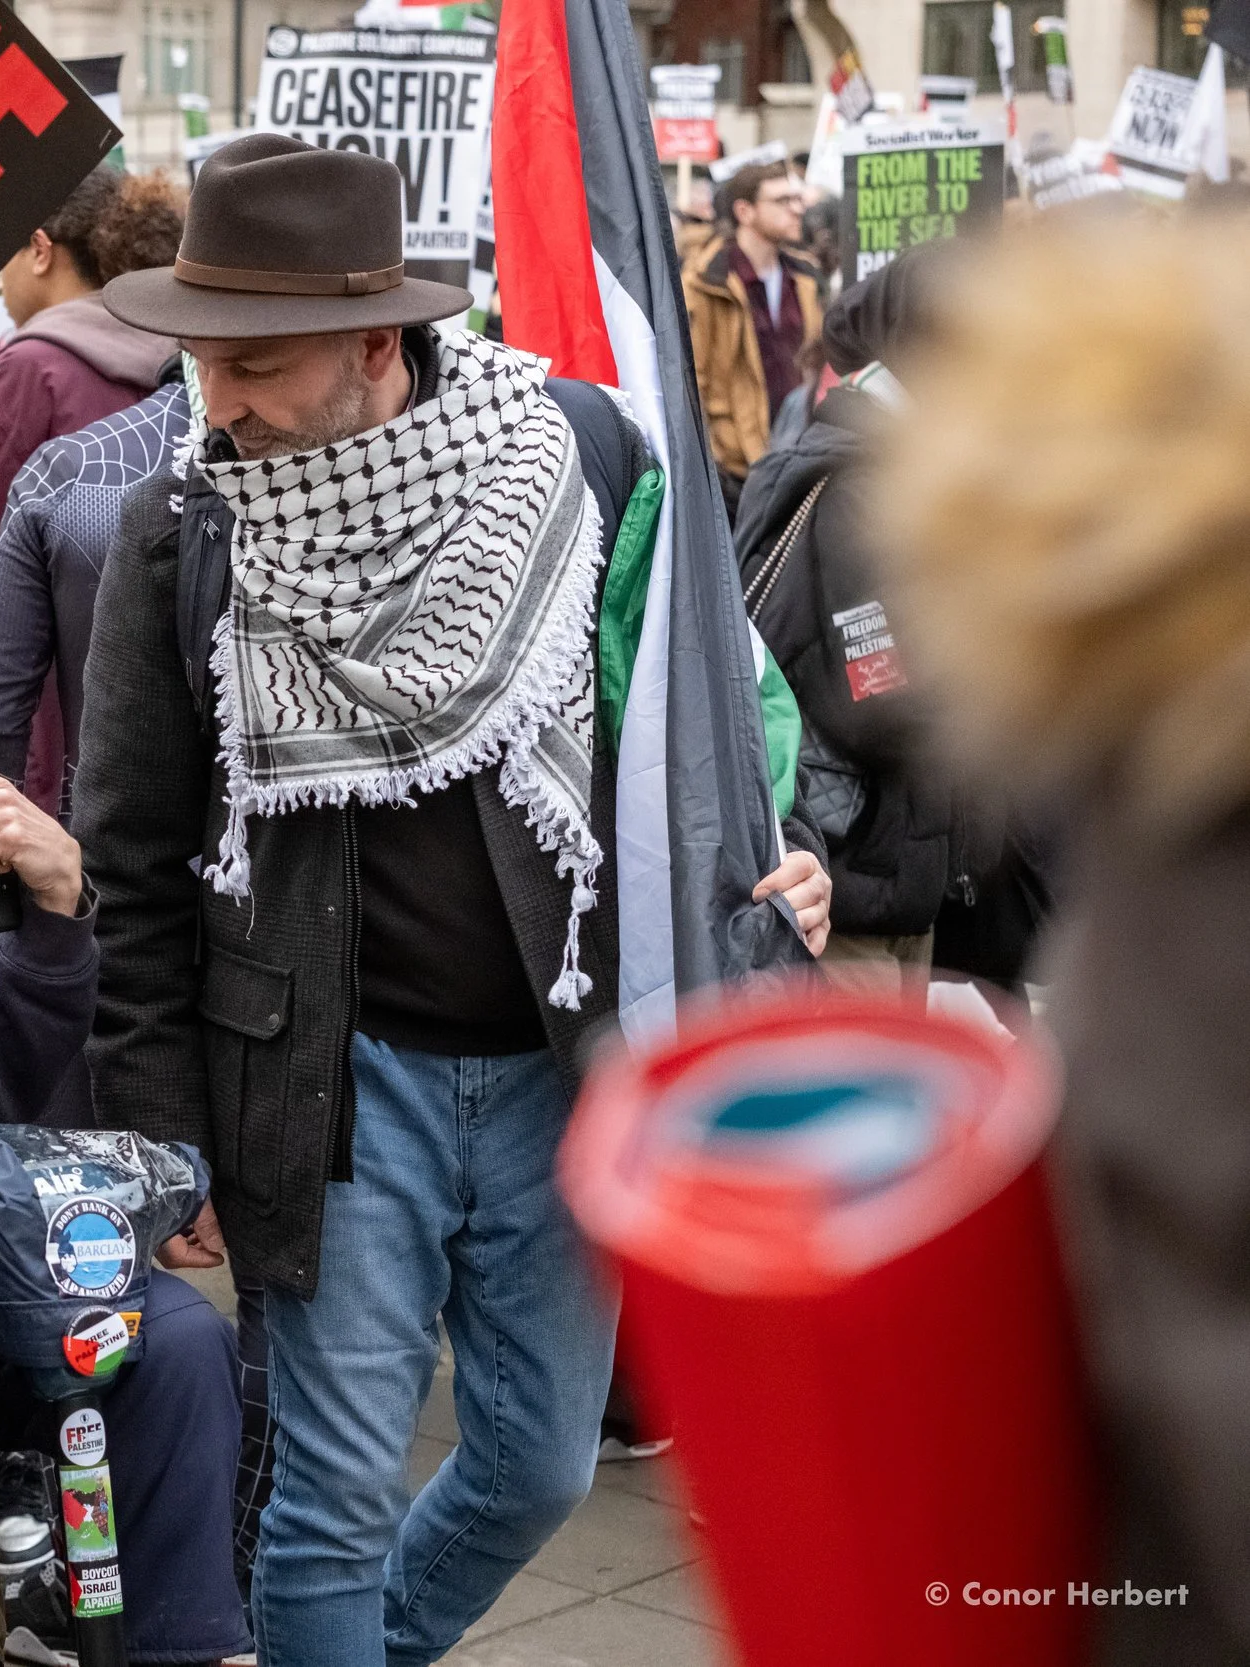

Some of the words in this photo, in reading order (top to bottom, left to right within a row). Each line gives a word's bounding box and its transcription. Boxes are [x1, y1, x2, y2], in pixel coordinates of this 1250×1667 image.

[270, 67, 482, 131] CEASEFIRE
[857, 150, 928, 187] FROM
[935, 147, 983, 182] THE
[857, 185, 929, 219] RIVER
[936, 182, 969, 213] TO
[857, 218, 901, 251] THE
[842, 612, 887, 641] FREEDOM
[844, 633, 894, 663] PALESTINE
[55, 1203, 80, 1231] DON'T
[81, 1200, 109, 1214] BANK
[110, 1211, 124, 1227] ON
[77, 1242, 132, 1258] BARCLAYS
[75, 1330, 127, 1363] PALESTINE
[84, 1328, 110, 1346] FREE
[67, 1438, 104, 1452] PALESTINE
[81, 1563, 119, 1580] BOYCOTT
[82, 1580, 117, 1595] ISRAELI
